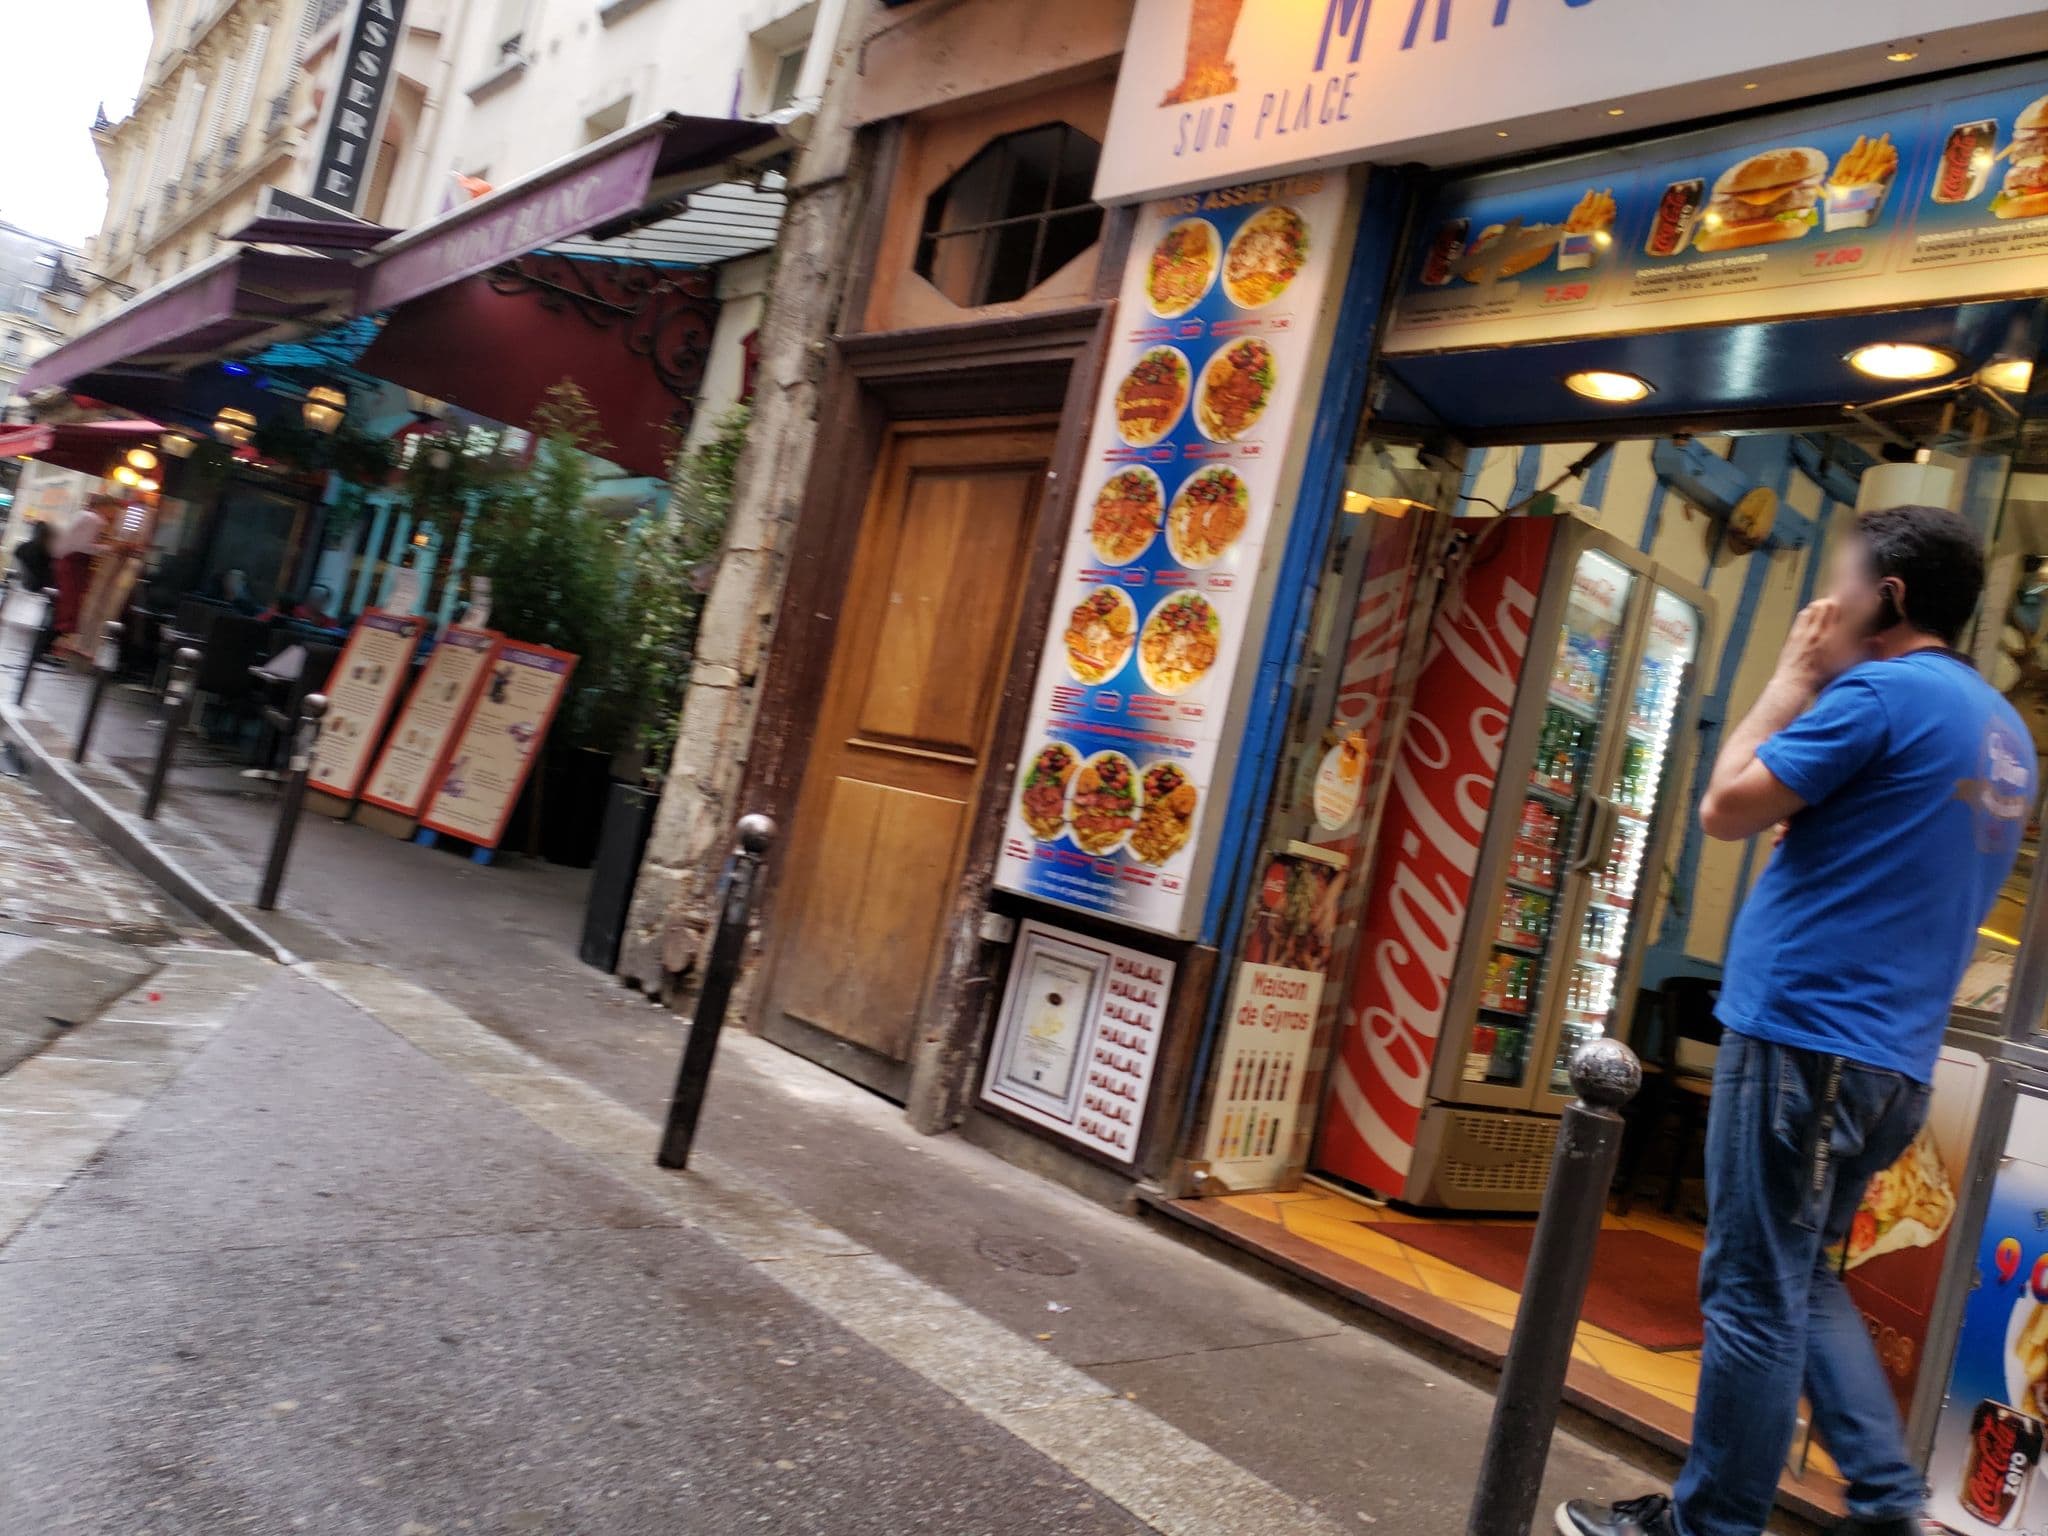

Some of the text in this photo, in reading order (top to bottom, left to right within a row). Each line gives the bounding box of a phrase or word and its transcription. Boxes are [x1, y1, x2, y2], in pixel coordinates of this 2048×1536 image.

[1173, 71, 1359, 156] SUR PLACE
[1328, 574, 1540, 1178] Coca-Cola
[1115, 956, 1164, 985] HALAL
[1251, 971, 1308, 1001] Maison
[1110, 979, 1159, 1008] HALAL
[1104, 1002, 1153, 1032] HALAL
[1237, 1000, 1310, 1034] de Gyros
[1099, 1025, 1148, 1055] HALAL
[1094, 1048, 1142, 1079] HALAL
[1088, 1070, 1137, 1102] HALAL
[1083, 1093, 1132, 1126] HALAL
[1078, 1115, 1127, 1150] HALAL
[2002, 1451, 2028, 1496] zero
